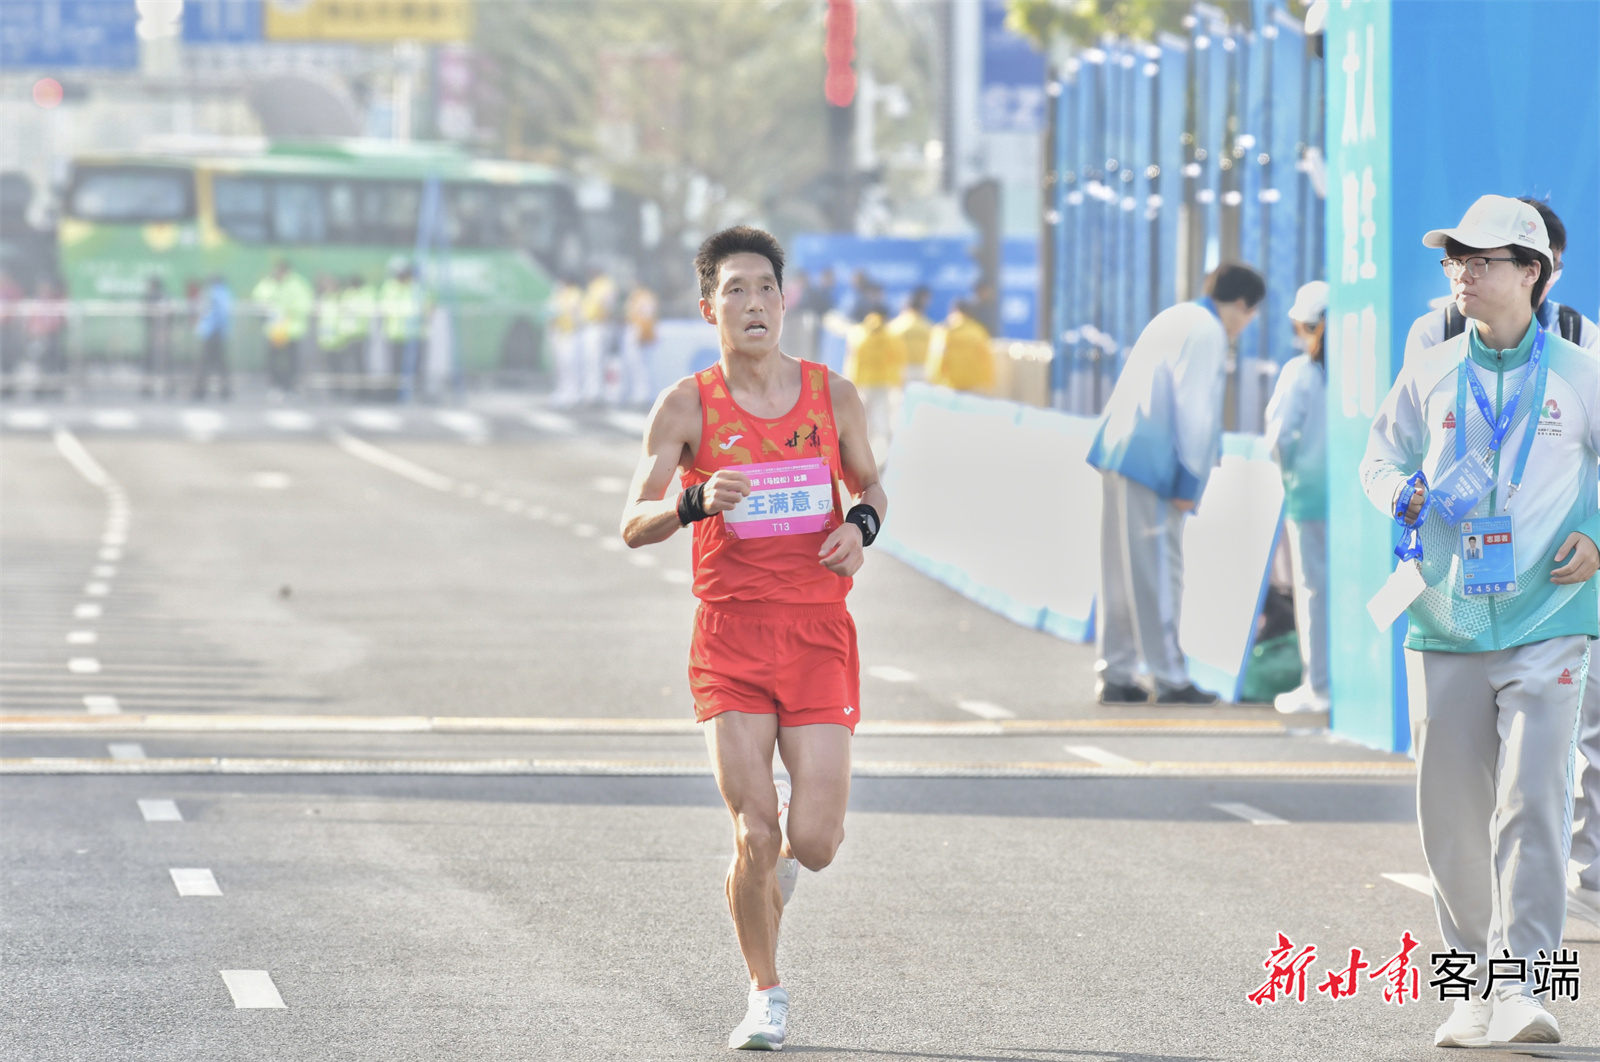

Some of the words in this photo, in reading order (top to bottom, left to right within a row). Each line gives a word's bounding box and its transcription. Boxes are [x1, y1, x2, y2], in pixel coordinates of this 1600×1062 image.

[785, 424, 820, 447] 甘肃
[747, 490, 811, 516] 王满意
[772, 522, 790, 532] T13
[1467, 583, 1500, 594] 2456
